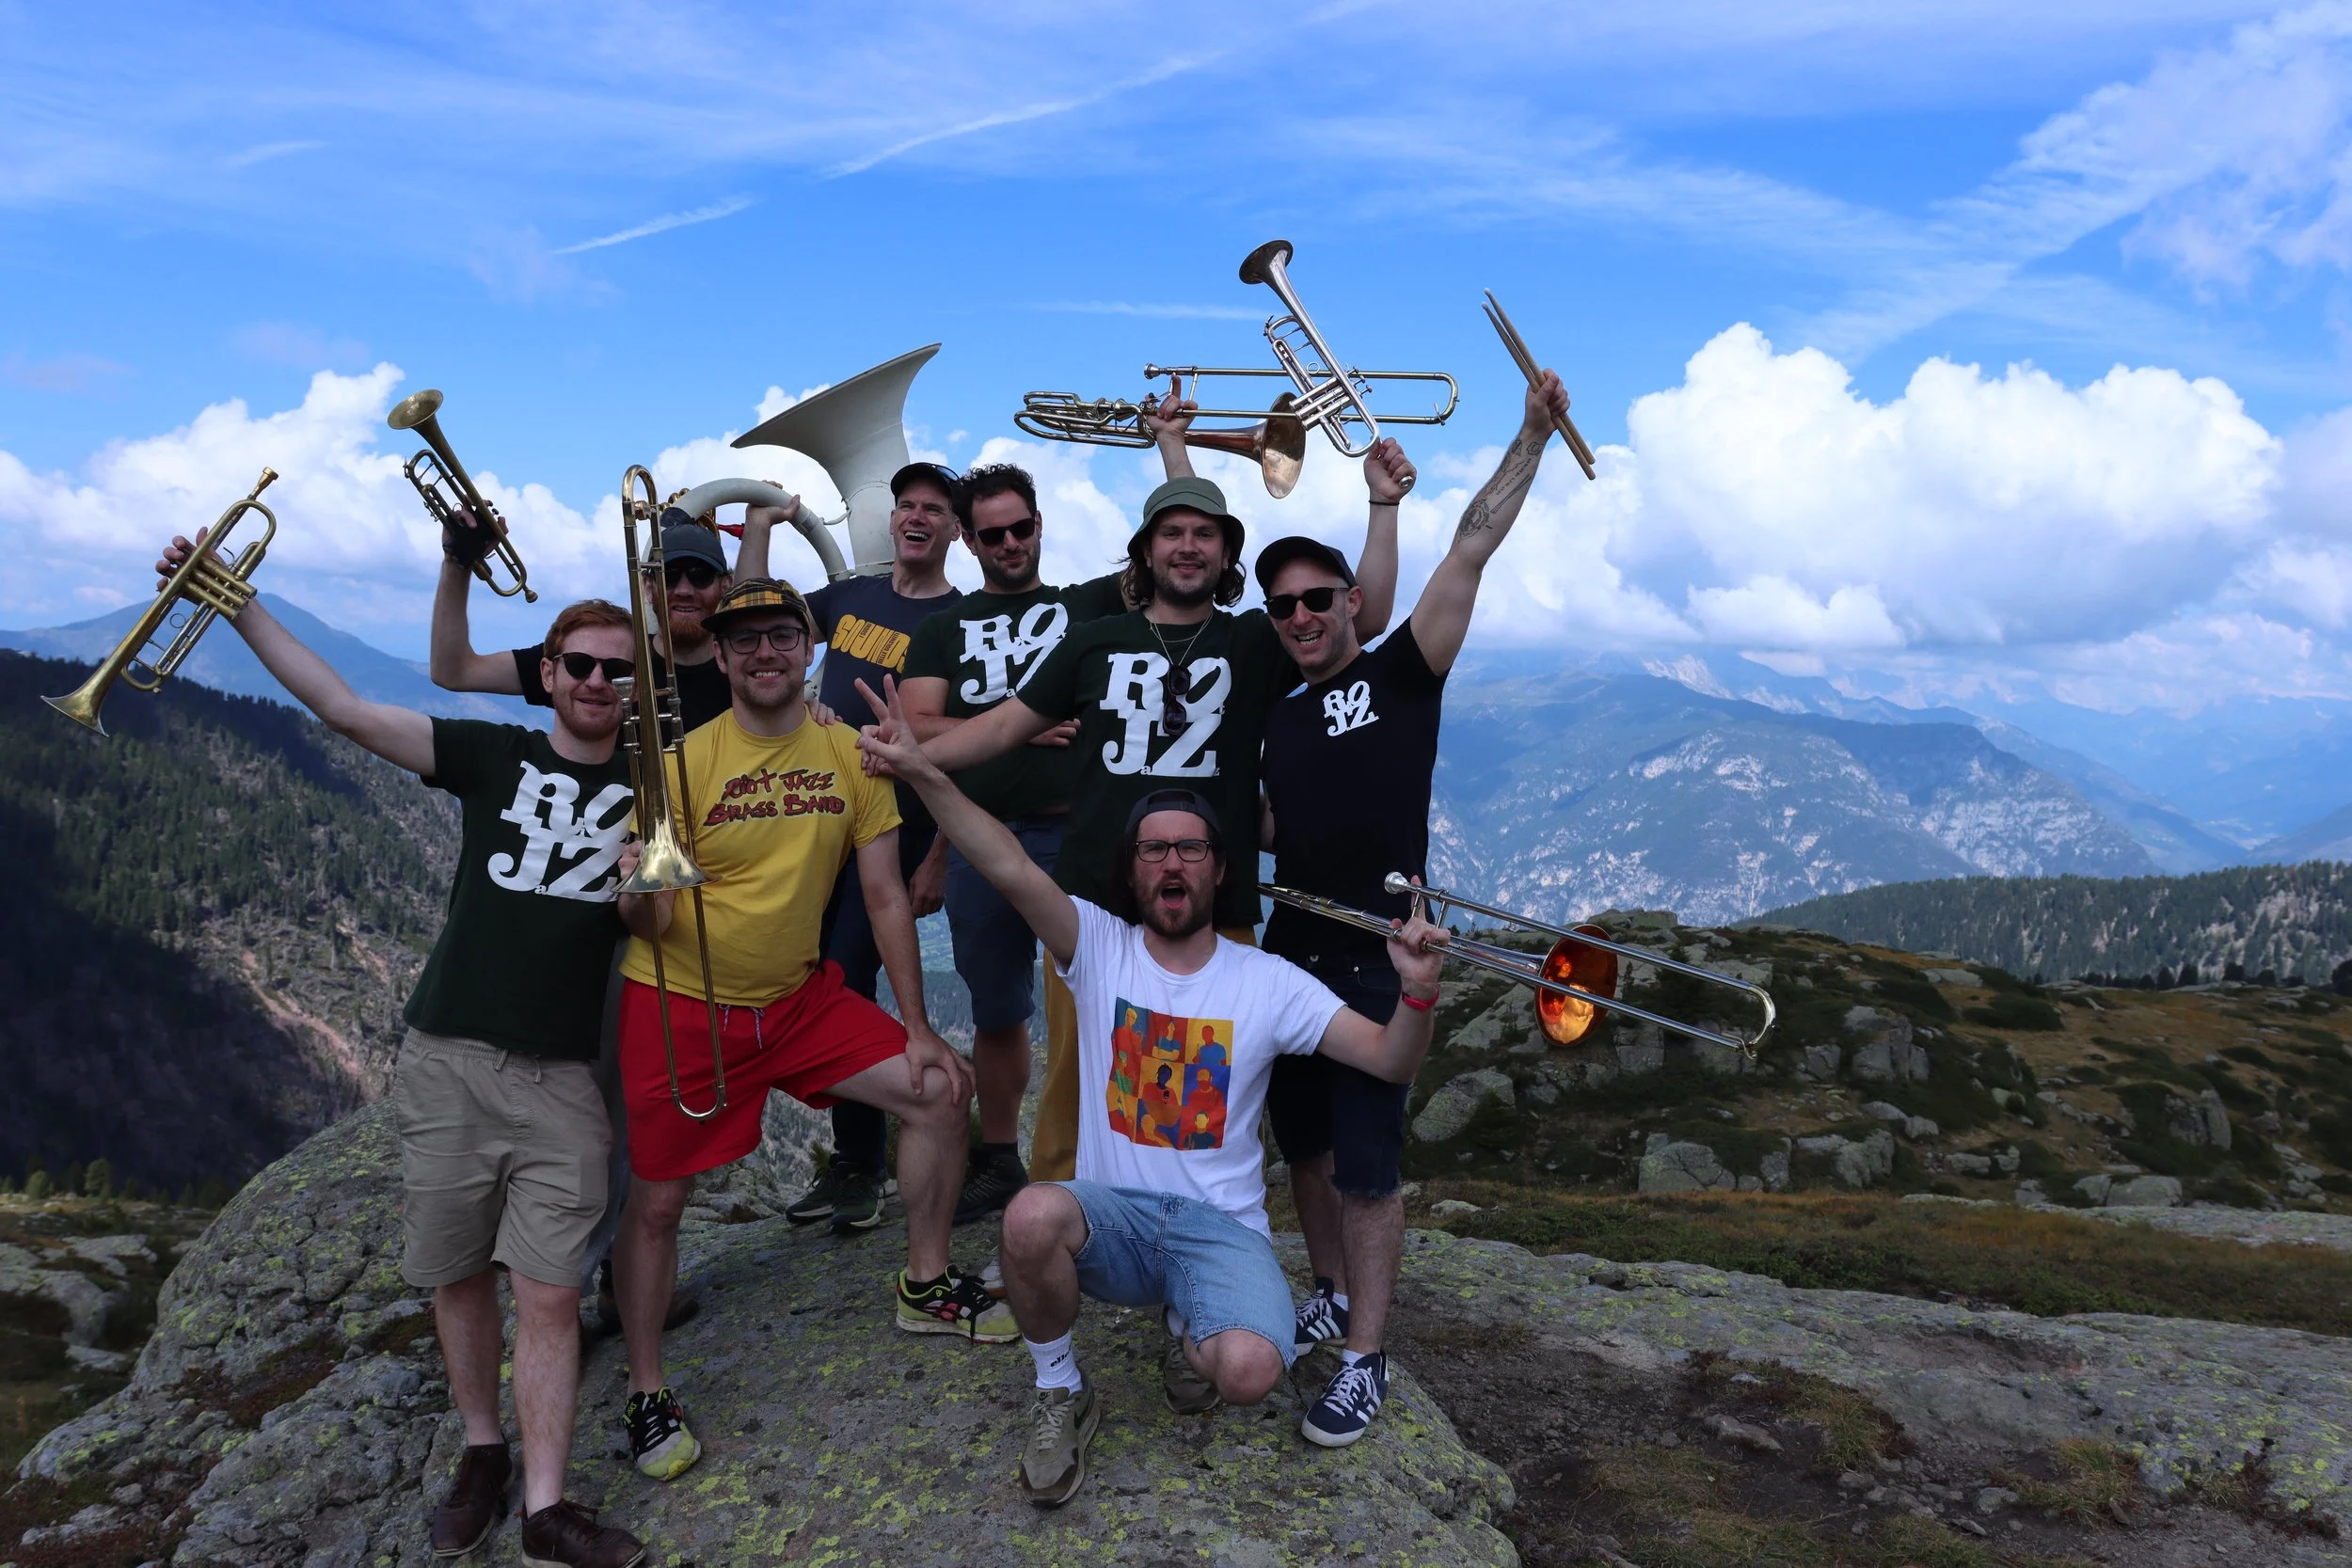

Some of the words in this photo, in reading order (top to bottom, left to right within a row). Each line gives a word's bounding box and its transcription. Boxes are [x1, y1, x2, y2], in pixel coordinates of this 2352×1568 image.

[779, 768, 835, 792] JAZZ
[704, 800, 779, 827] BRASS
[783, 794, 846, 816] BAND
